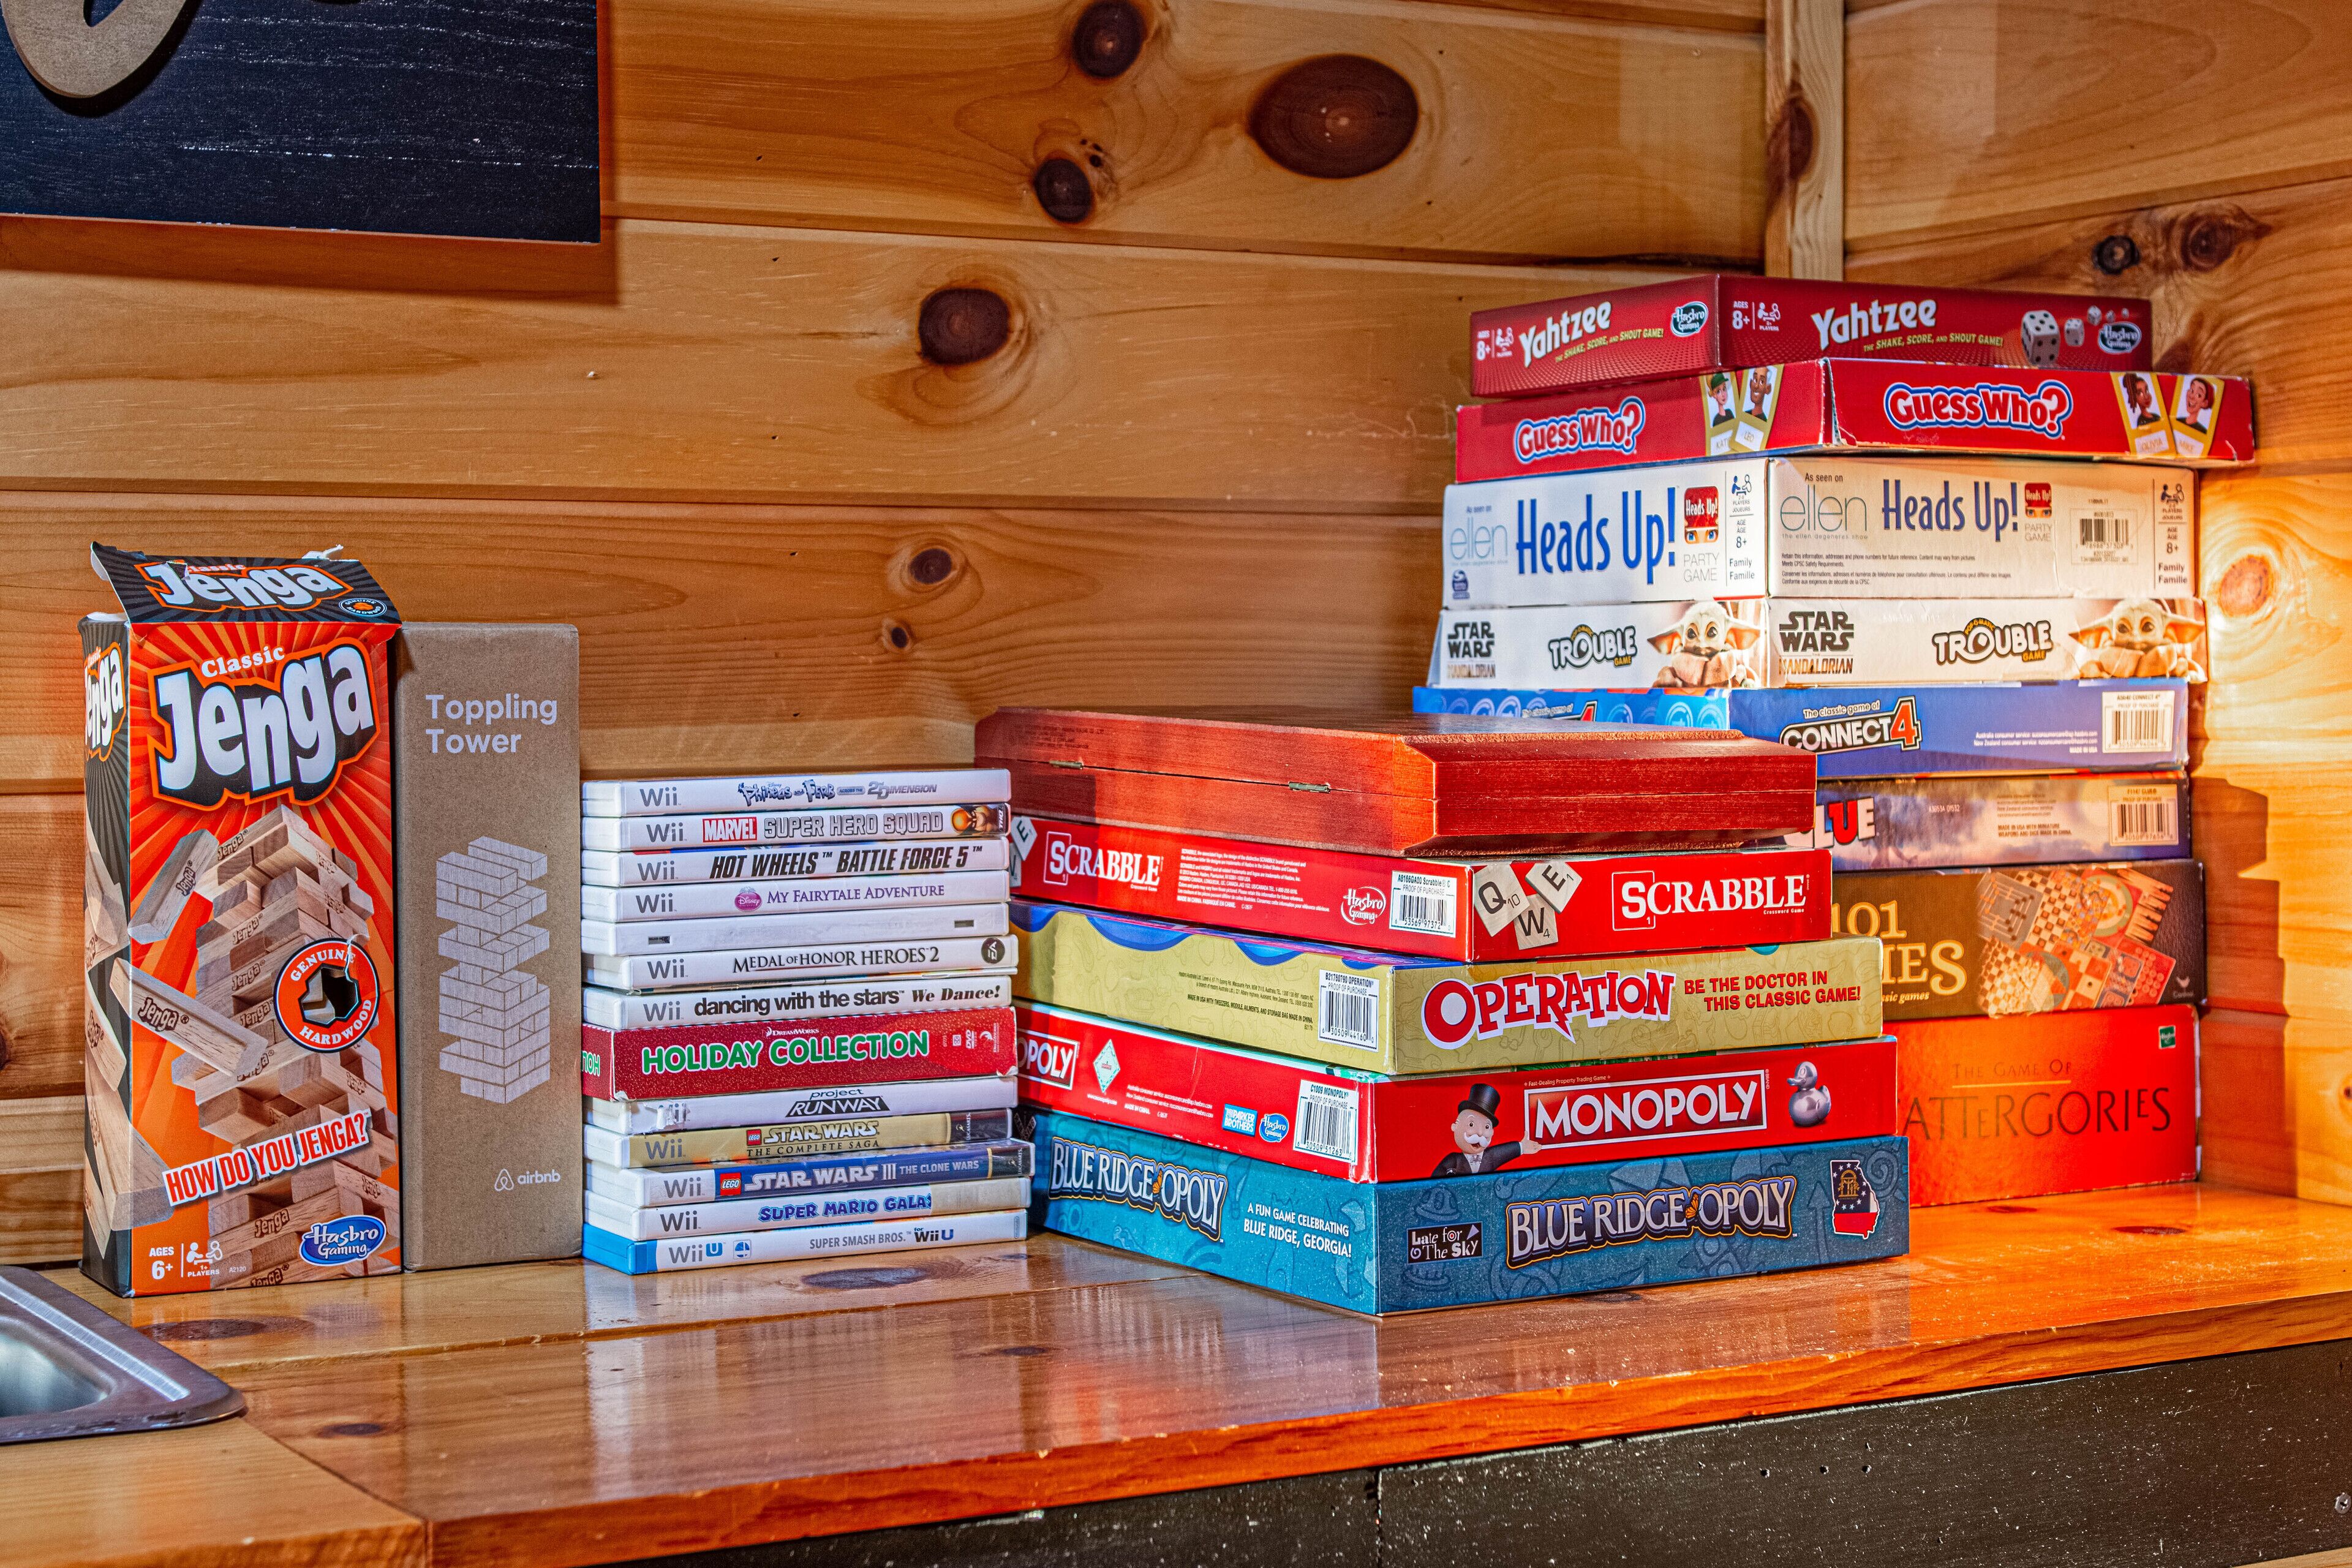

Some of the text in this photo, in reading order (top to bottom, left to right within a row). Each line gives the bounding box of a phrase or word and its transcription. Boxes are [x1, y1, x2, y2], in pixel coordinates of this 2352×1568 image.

[1518, 301, 1612, 368] Yahtzee
[1732, 310, 1751, 330] 8+
[1810, 298, 1937, 351] Yahtzee
[1863, 343, 1874, 352] THE
[1875, 337, 1905, 350] SHAKE,
[1906, 333, 1934, 345] SCORE,
[1949, 333, 1977, 344] SHOUT
[1978, 335, 2003, 347] GAME!
[1804, 472, 1844, 482] As seen on
[1780, 484, 1868, 532] ellen
[1882, 478, 1966, 532] Heads
[1973, 481, 2018, 543] Up!
[1450, 516, 1509, 560] ellen
[1515, 486, 1676, 586] Heads Up!
[1736, 537, 1747, 548] 8+
[2024, 523, 2052, 532] PARTY
[2024, 533, 2052, 541] GAME
[1684, 552, 1720, 567] PARTY
[1729, 557, 1752, 569] Family
[2158, 562, 2185, 573] Family
[144, 564, 343, 607] Jenga
[1730, 570, 1755, 580] Famille
[2158, 575, 2188, 584] Famille
[1447, 621, 1494, 639] STAR
[1779, 611, 1855, 631] STAR
[1447, 641, 1496, 659] WARS
[1548, 625, 1638, 671] TROUBLE
[1931, 620, 2054, 666] TROUBLE
[201, 646, 285, 678] Classic
[1613, 655, 1632, 667] GAME
[157, 646, 374, 791] Jenga
[425, 693, 558, 725] Toppling
[1803, 700, 1880, 719] The classic game of
[425, 728, 522, 753] Tower
[1783, 700, 1918, 751] CONNECT 4
[646, 811, 943, 843] Wii MARVEL SUPER HERO SQUAD
[638, 846, 969, 881] Wii HOT WHEELS BATTLE FORCE 5
[1050, 840, 1161, 886] SCRABBLE
[1541, 864, 1566, 892] E
[1478, 881, 1507, 914] Q
[1507, 893, 1521, 909] 10
[1621, 874, 1806, 919] SCRABBLE
[1518, 907, 1545, 937] W
[1543, 928, 1550, 938] 4
[1831, 900, 1907, 939] 101
[290, 949, 356, 981] GENUINE
[1684, 970, 1828, 995] BE THE DOCTOR IN
[1899, 992, 1929, 1003] games
[643, 985, 1001, 1022] Wii dancing with the stars We Dance!
[1423, 971, 1676, 1043] OPERATION
[1704, 986, 1861, 1012] THIS CLASSIC GAME!
[138, 998, 179, 1031] Jenga
[299, 999, 372, 1045] HARDWOOD
[1331, 1027, 1366, 1042] 30509 44160
[643, 1030, 929, 1075] HOLIDAY COLLECTION
[790, 1096, 881, 1117] RUNWAY
[810, 1088, 864, 1100] project
[1535, 1080, 1758, 1139] MONOPOLY
[1899, 1087, 2171, 1141] ATTERGORIES
[645, 1120, 879, 1159] Wii STAR WARS
[747, 1140, 880, 1157] THE COMPLETE SAGA
[1306, 1141, 1343, 1156] 30509 51263
[165, 1113, 366, 1204] HOW DO YOU JENGA?
[517, 1169, 561, 1185] airbnb
[664, 1160, 979, 1199] Wii LEGO STAR WARS III THE CLONE WARS
[1050, 1142, 1224, 1231] BLUE RIDGE OPOLY
[255, 1208, 290, 1238] Jenga
[1247, 1202, 1349, 1237] A FUN GAME CELEBRATING
[1510, 1181, 1791, 1258] BLUE RIDGE OPOLY
[304, 1226, 379, 1245] Hasbro
[317, 1243, 368, 1258] Gaming
[668, 1229, 954, 1264] Wii U SUPER SMASH BROS. Wii U
[1243, 1218, 1352, 1257] BLUE RIDGE, GEORGIA!
[1411, 1227, 1463, 1245] Late for
[1422, 1240, 1479, 1260] The Sky
[149, 1246, 175, 1257] AGES
[152, 1262, 173, 1280] 6+
[187, 1268, 220, 1278] PLAYERS
